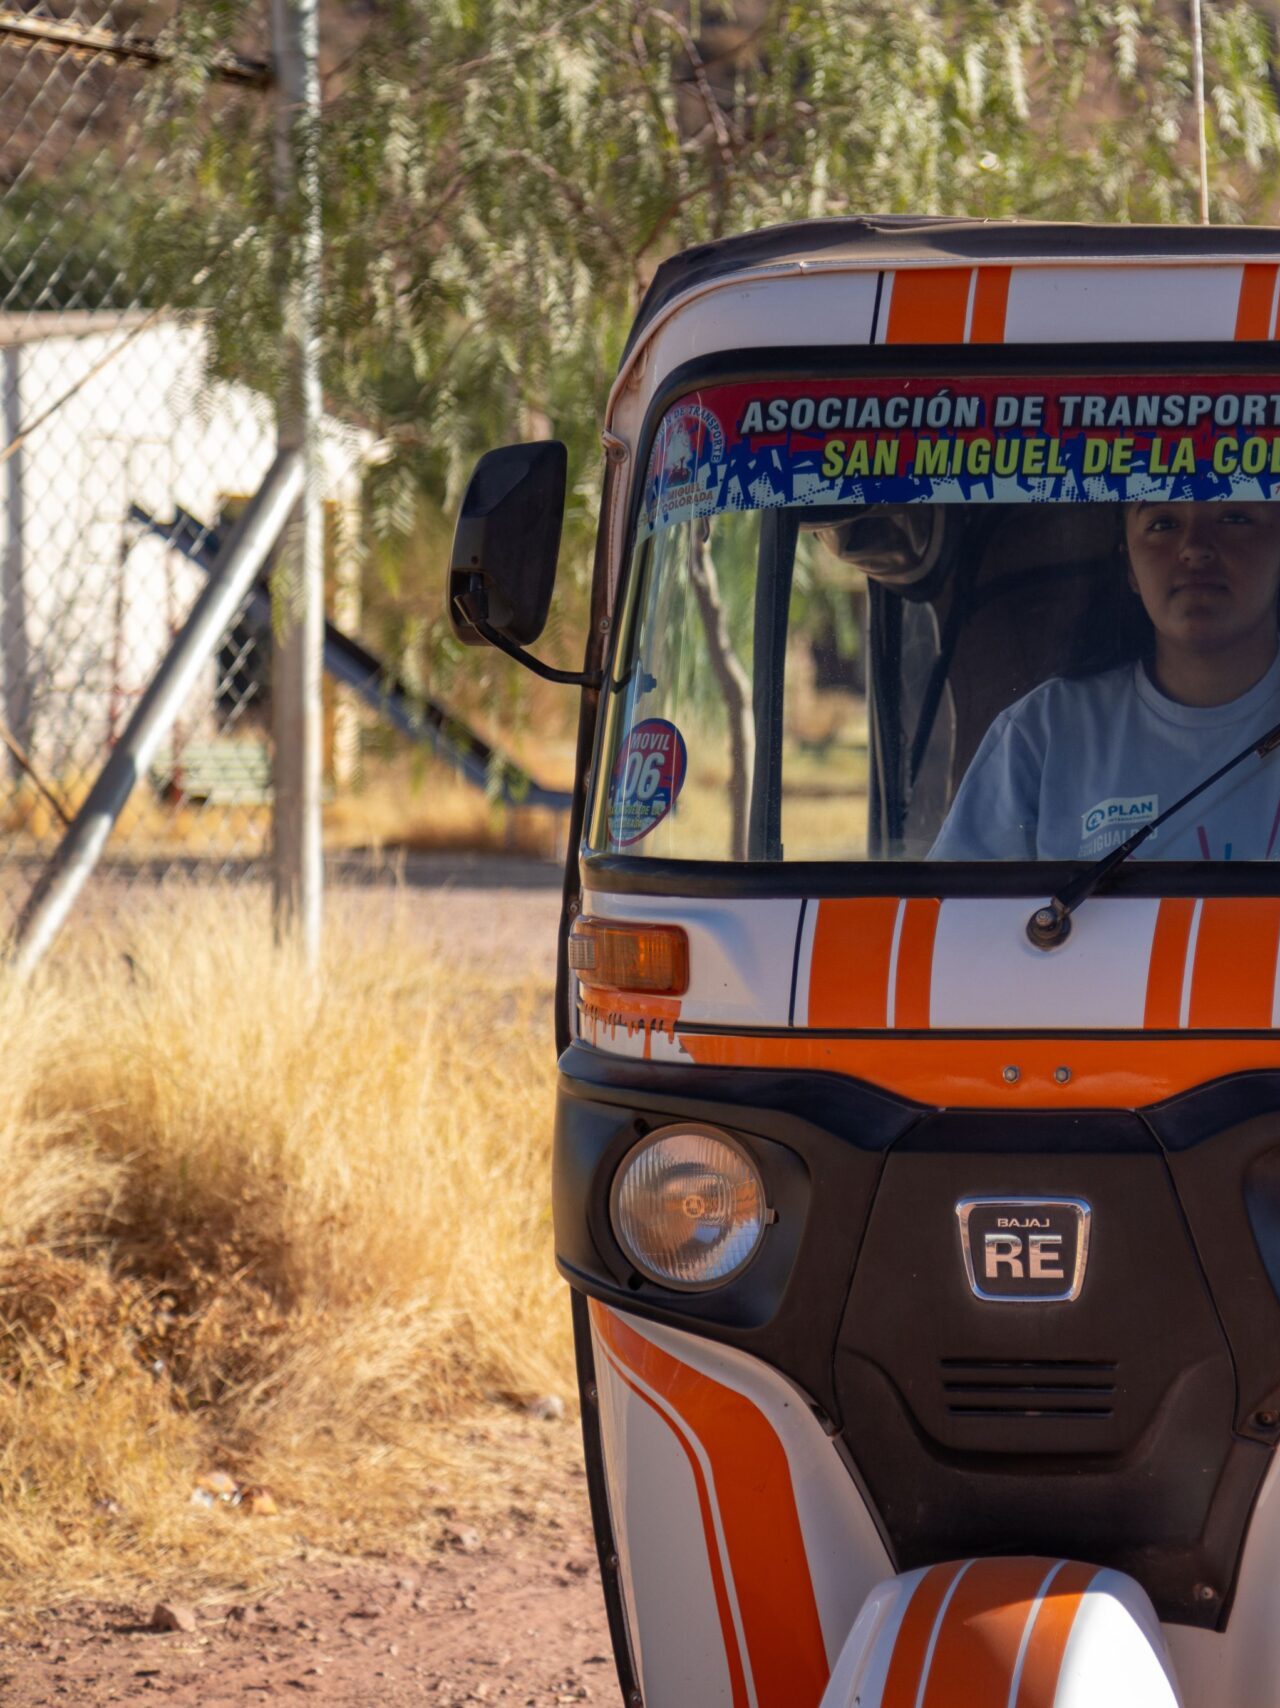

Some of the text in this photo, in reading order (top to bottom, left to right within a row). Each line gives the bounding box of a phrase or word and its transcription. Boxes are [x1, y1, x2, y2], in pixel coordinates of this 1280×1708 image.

[740, 390, 980, 434] ASOCIACIÓN
[994, 396, 1045, 427] DE
[822, 438, 900, 477] SAN
[914, 438, 1068, 475] MIGUEL
[1082, 438, 1134, 475] DE
[1148, 437, 1196, 474] LA
[630, 732, 670, 751] MOVIL
[619, 751, 665, 801] 06
[1107, 801, 1153, 817] PLAN
[997, 1218, 1050, 1228] BAJAJ
[984, 1234, 1064, 1279] RE
